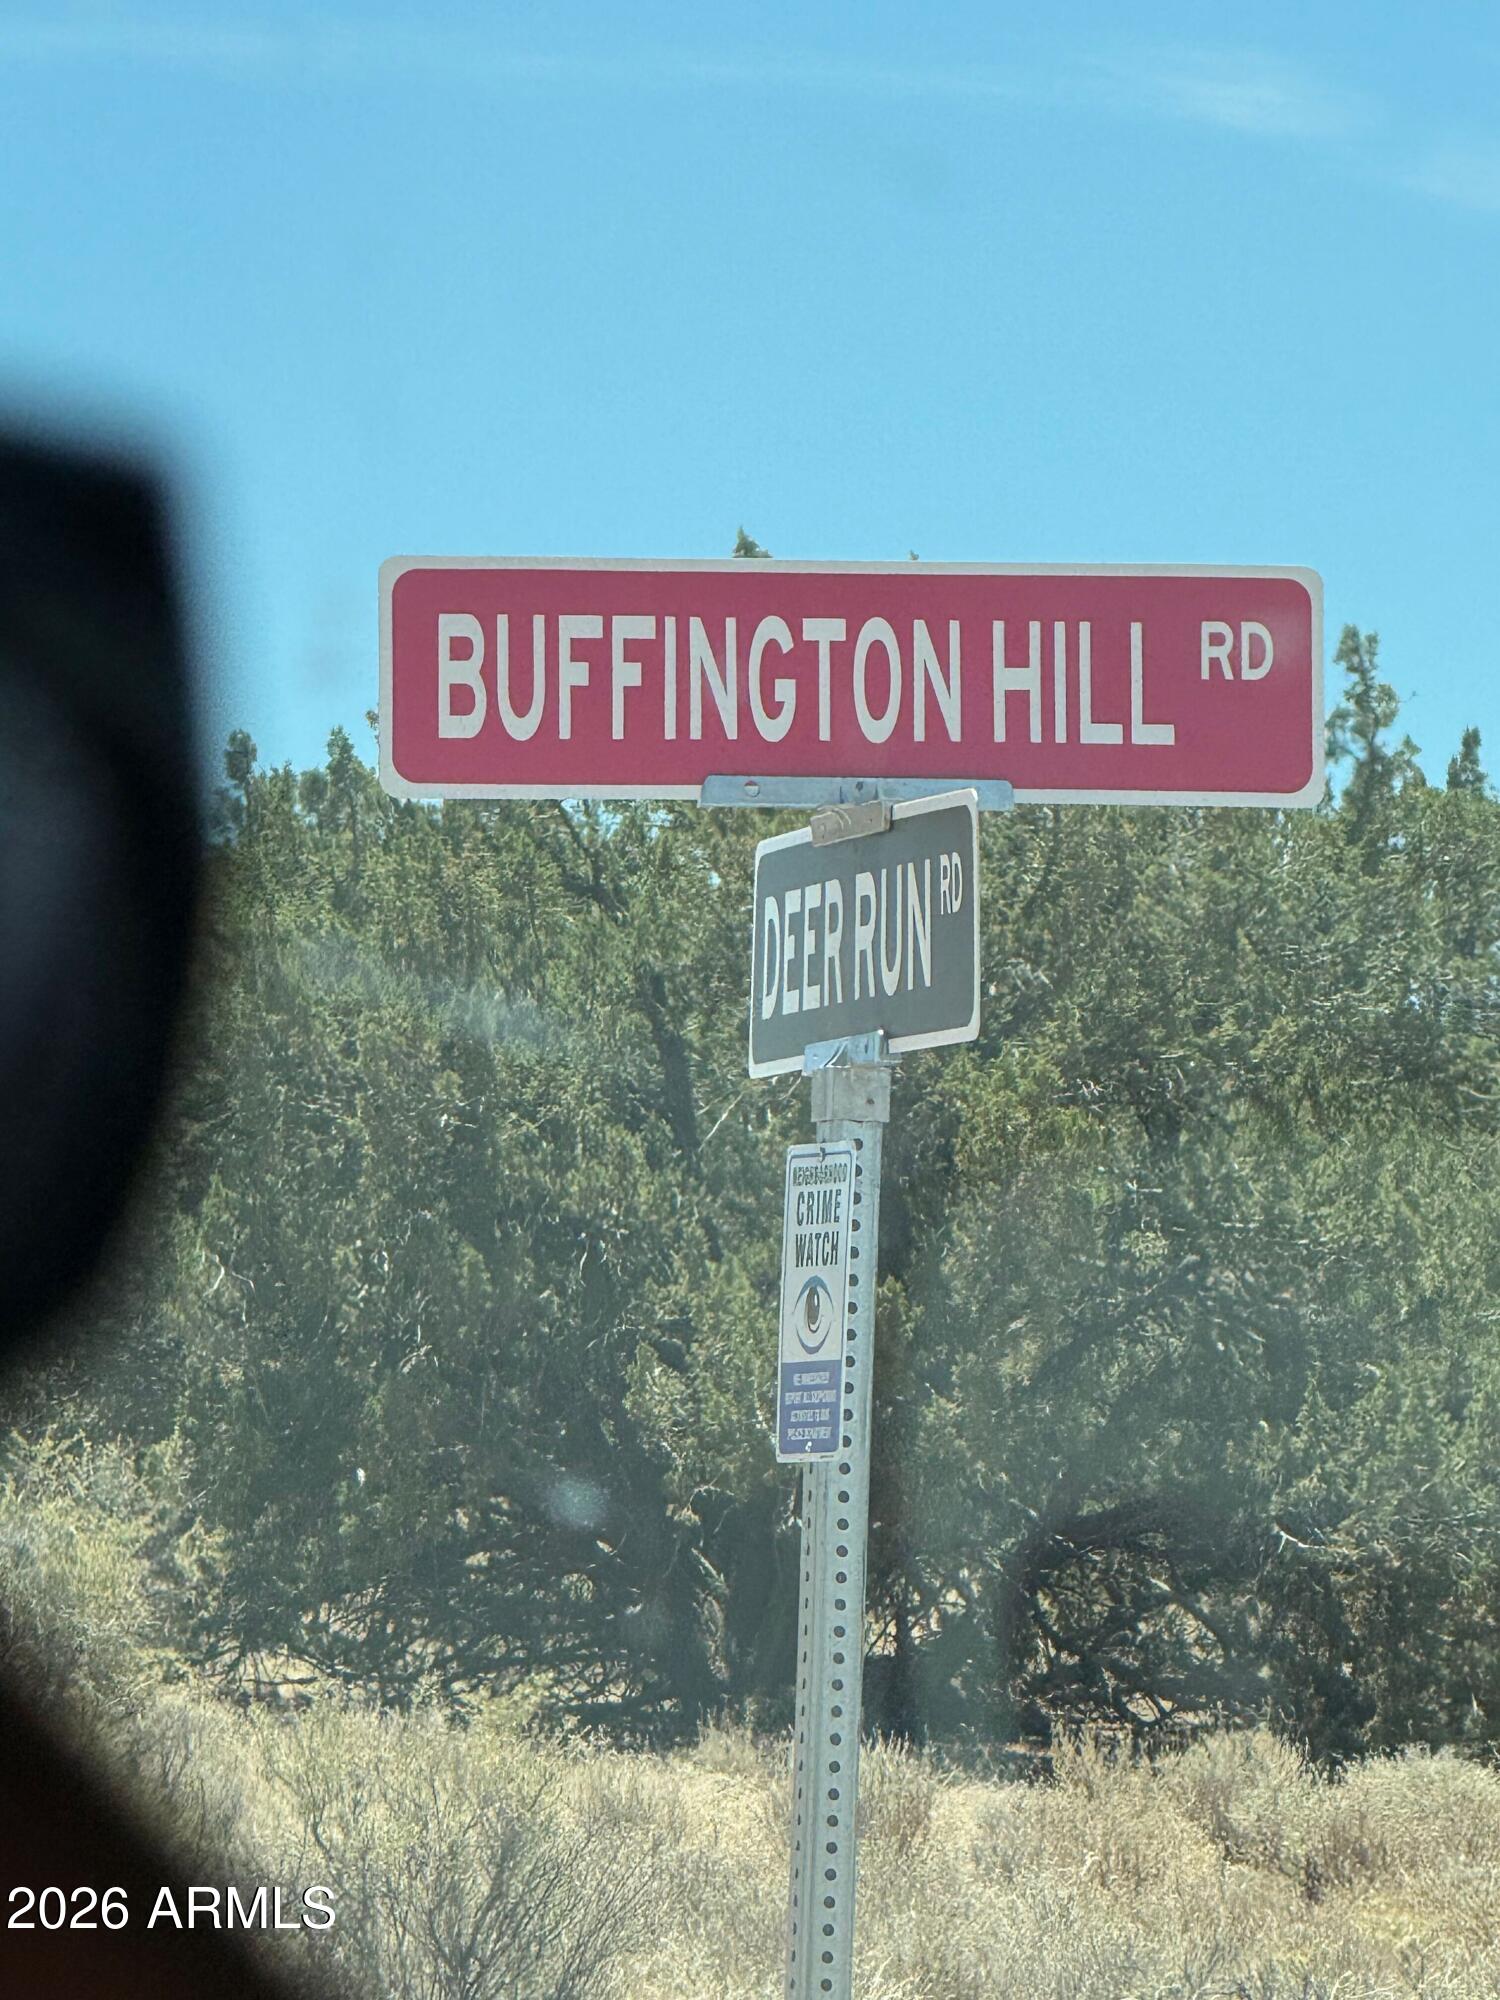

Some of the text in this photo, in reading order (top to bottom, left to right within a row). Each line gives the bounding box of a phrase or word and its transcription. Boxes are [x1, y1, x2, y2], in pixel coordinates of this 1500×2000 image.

[437, 612, 1275, 746] BUFFINGTON HILL RD
[761, 851, 963, 1021] DEER RUN RD
[795, 1230, 840, 1268] WATCH
[796, 1188, 842, 1227] CRIME
